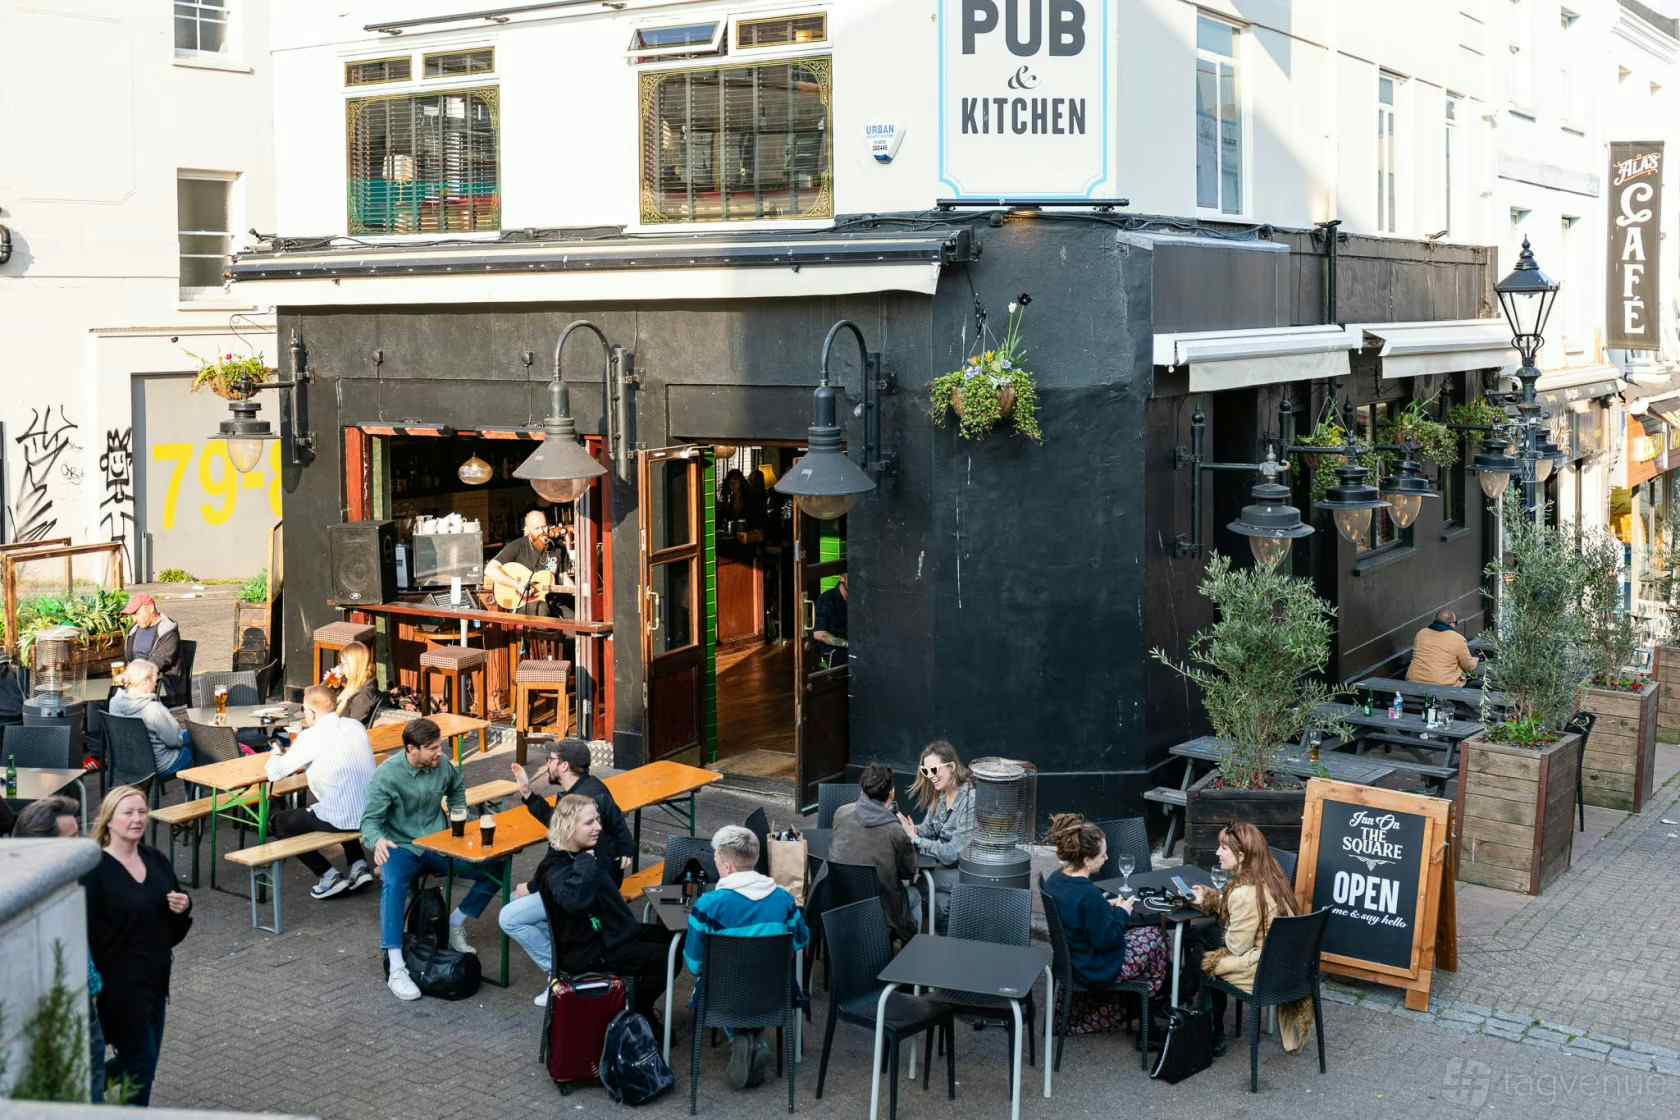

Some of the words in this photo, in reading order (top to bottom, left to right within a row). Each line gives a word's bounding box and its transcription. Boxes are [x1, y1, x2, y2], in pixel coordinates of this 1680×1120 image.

[961, 0, 1086, 57] PUB
[1007, 65, 1038, 90] &
[961, 97, 1087, 135] KITCHEN
[865, 124, 895, 135] URBAN
[1616, 182, 1654, 335] CAFÉ
[1349, 811, 1374, 827] Inn
[1375, 814, 1401, 831] On
[1360, 826, 1388, 843] THE
[1342, 836, 1404, 860] SQUARE
[1332, 870, 1401, 915] OPEN
[1350, 910, 1361, 919] &
[1381, 914, 1407, 928] hello
